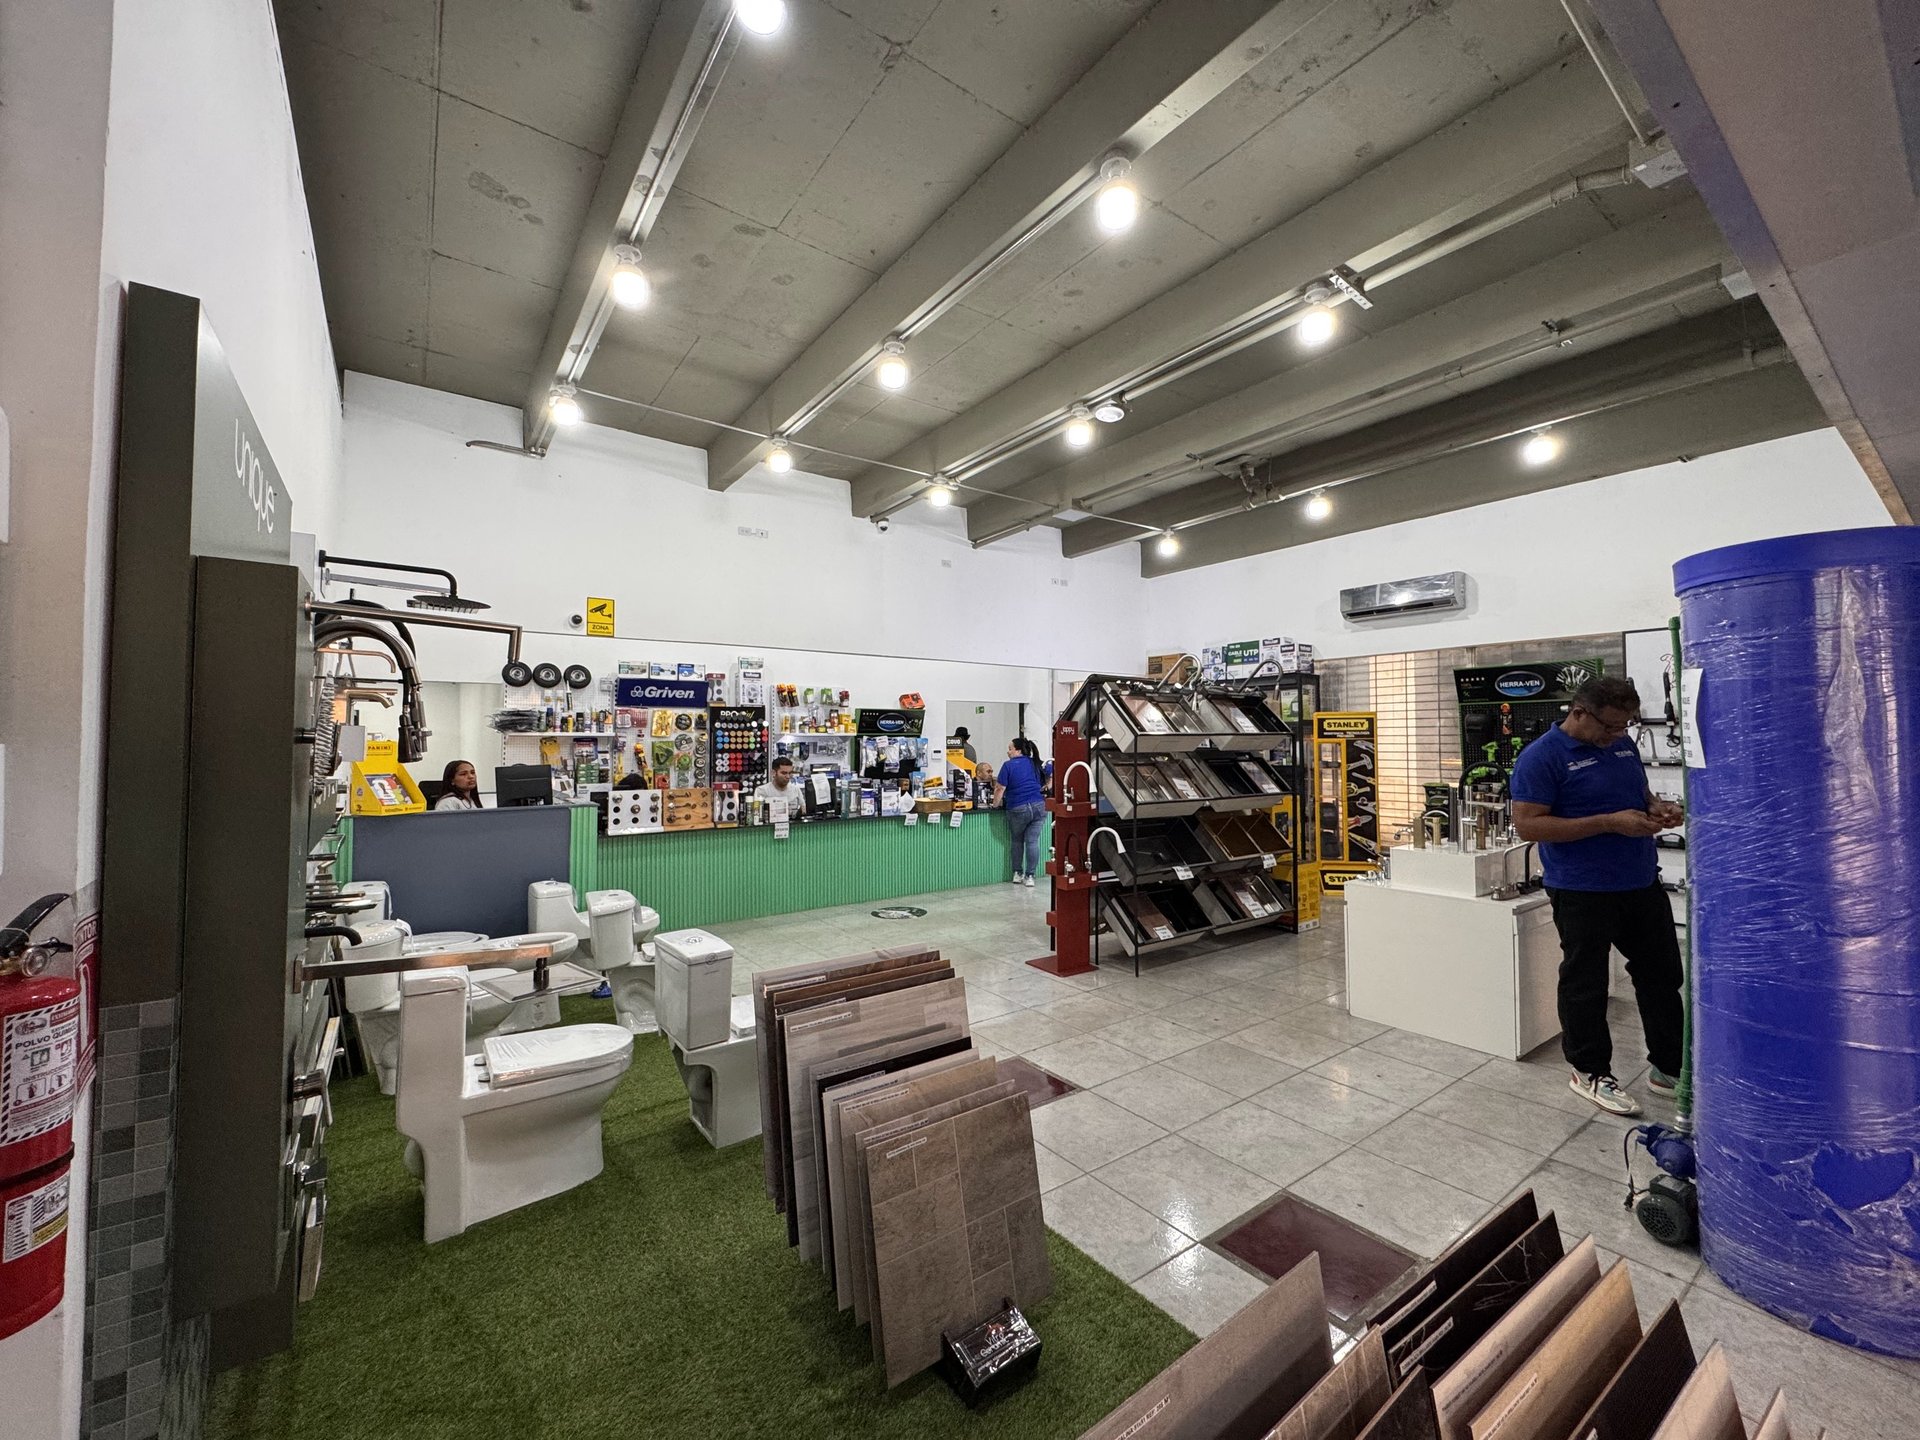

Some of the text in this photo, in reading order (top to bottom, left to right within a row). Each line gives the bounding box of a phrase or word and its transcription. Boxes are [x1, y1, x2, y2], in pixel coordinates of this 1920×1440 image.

[1243, 649, 1259, 657] UTP
[1499, 680, 1541, 688] HERRA-VEN
[644, 686, 695, 699] Griven
[1328, 875, 1357, 883] STAN
[15, 1035, 50, 1050] POLVO
